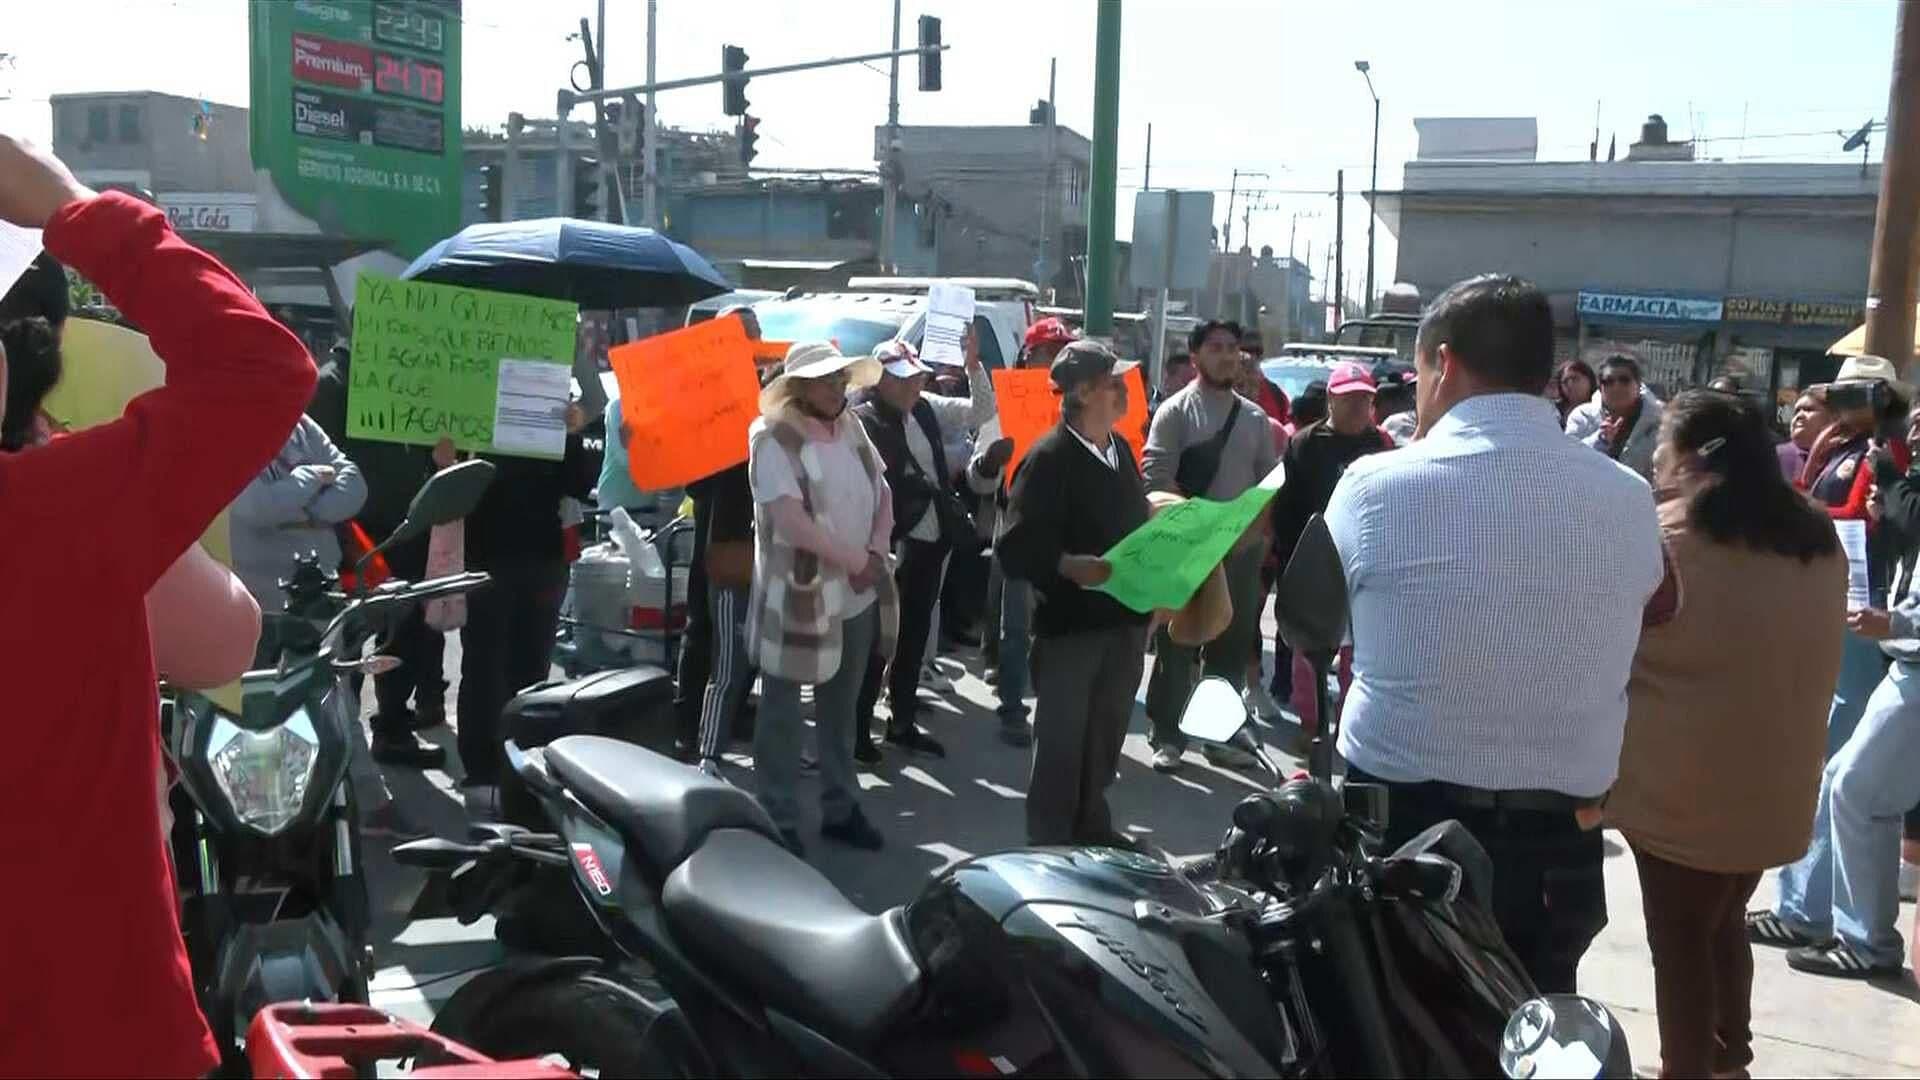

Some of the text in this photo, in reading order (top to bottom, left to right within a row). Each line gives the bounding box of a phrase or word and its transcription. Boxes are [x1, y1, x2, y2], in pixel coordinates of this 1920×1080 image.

[296, 48, 363, 78] Premium
[296, 102, 345, 128] Diesel
[361, 275, 397, 311] YA
[1579, 295, 1680, 316] FARMACIA
